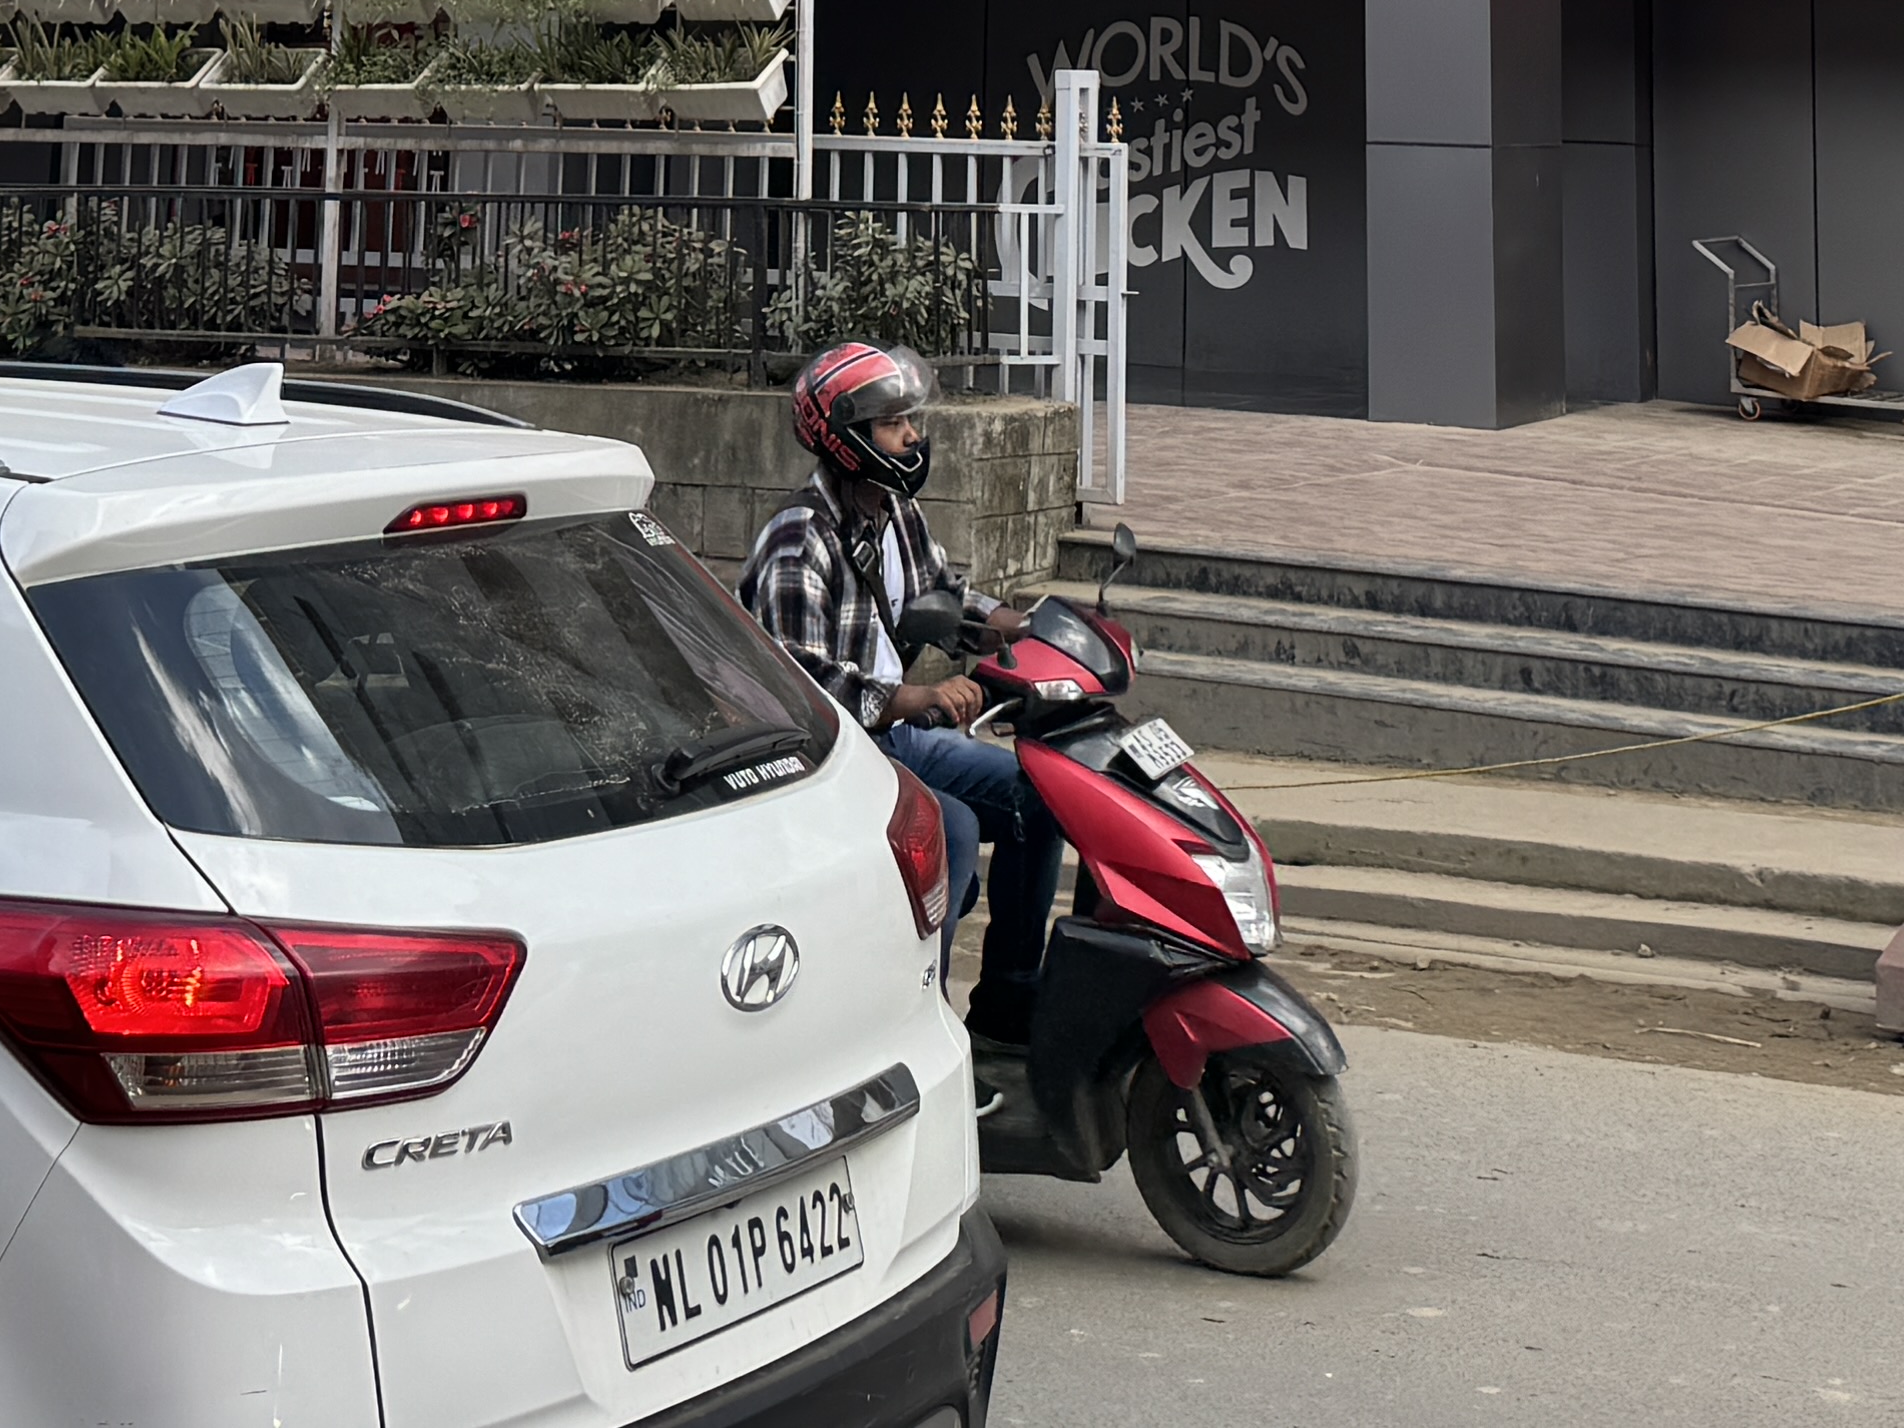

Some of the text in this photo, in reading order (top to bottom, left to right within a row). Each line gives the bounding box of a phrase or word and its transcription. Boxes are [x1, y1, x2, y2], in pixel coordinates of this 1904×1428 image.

[1026, 16, 1308, 116] WORLD'S
[362, 1120, 514, 1171] CRETA
[650, 1248, 702, 1332] NL
[776, 1182, 851, 1275] 6422
